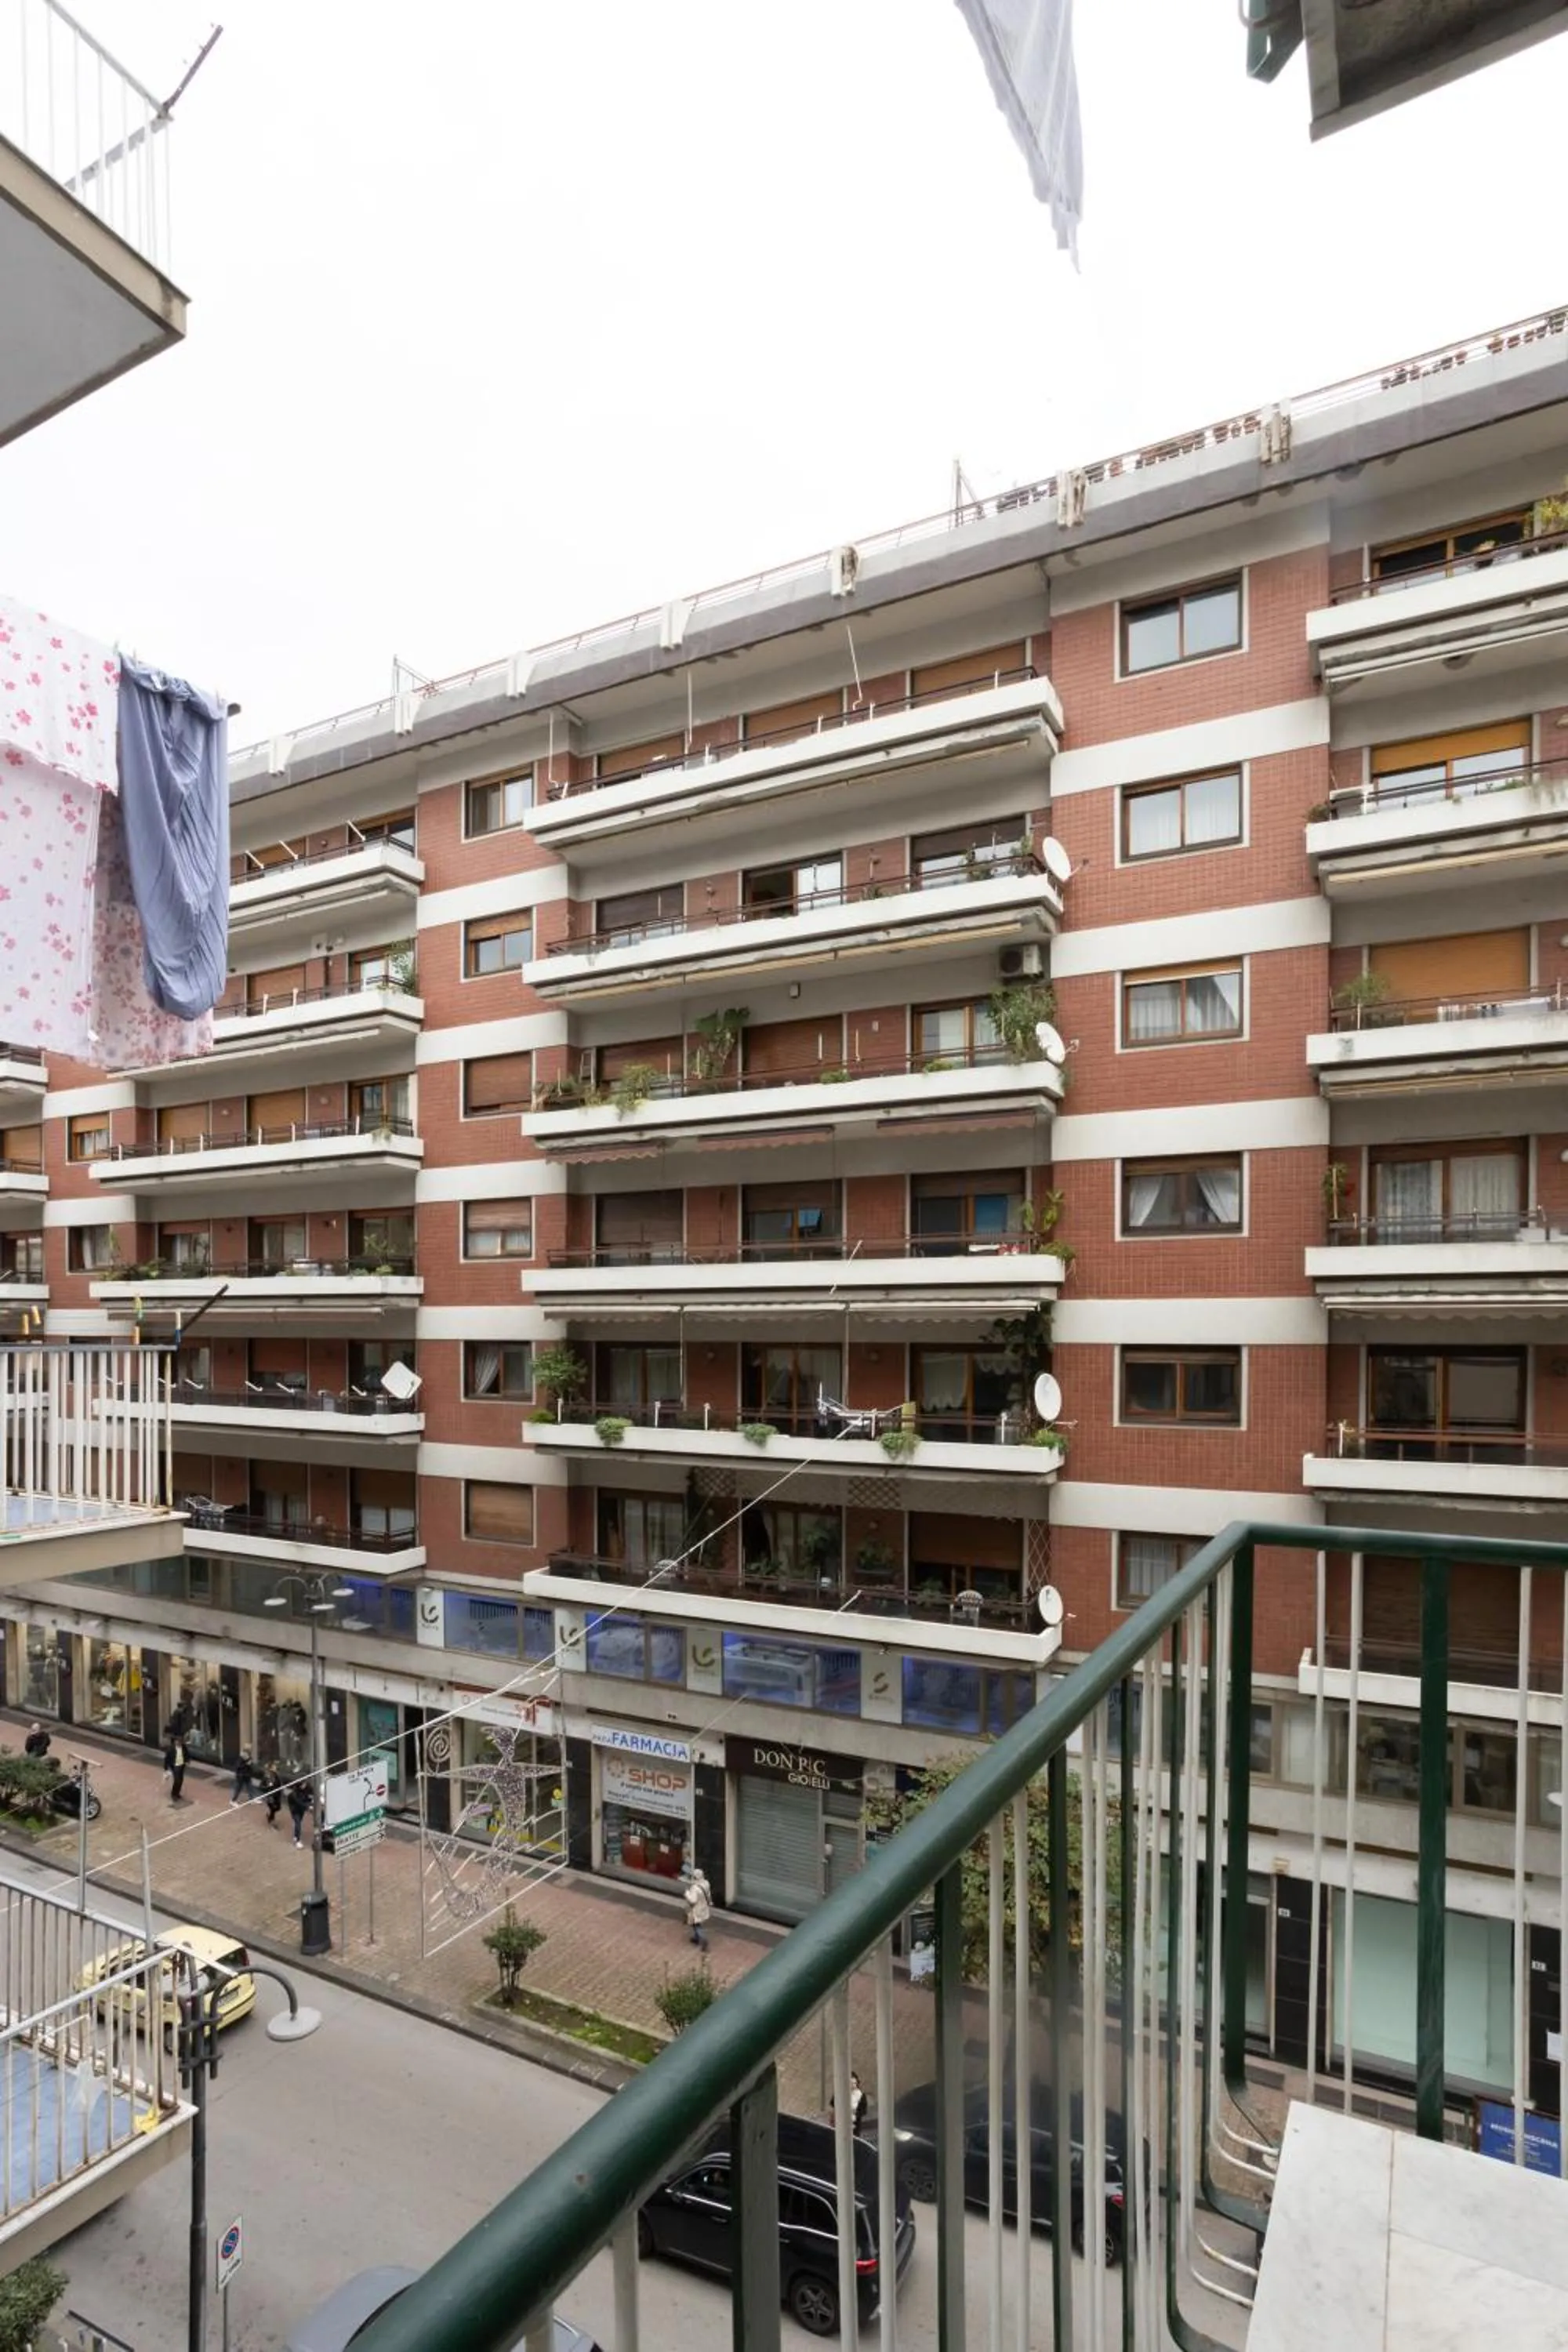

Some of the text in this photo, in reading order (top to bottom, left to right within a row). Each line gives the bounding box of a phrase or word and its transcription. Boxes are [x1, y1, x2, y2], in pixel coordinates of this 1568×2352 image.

[753, 1748, 793, 1770] DON
[628, 1767, 688, 1791] SHOP
[788, 1773, 830, 1791] GIOIELLI
